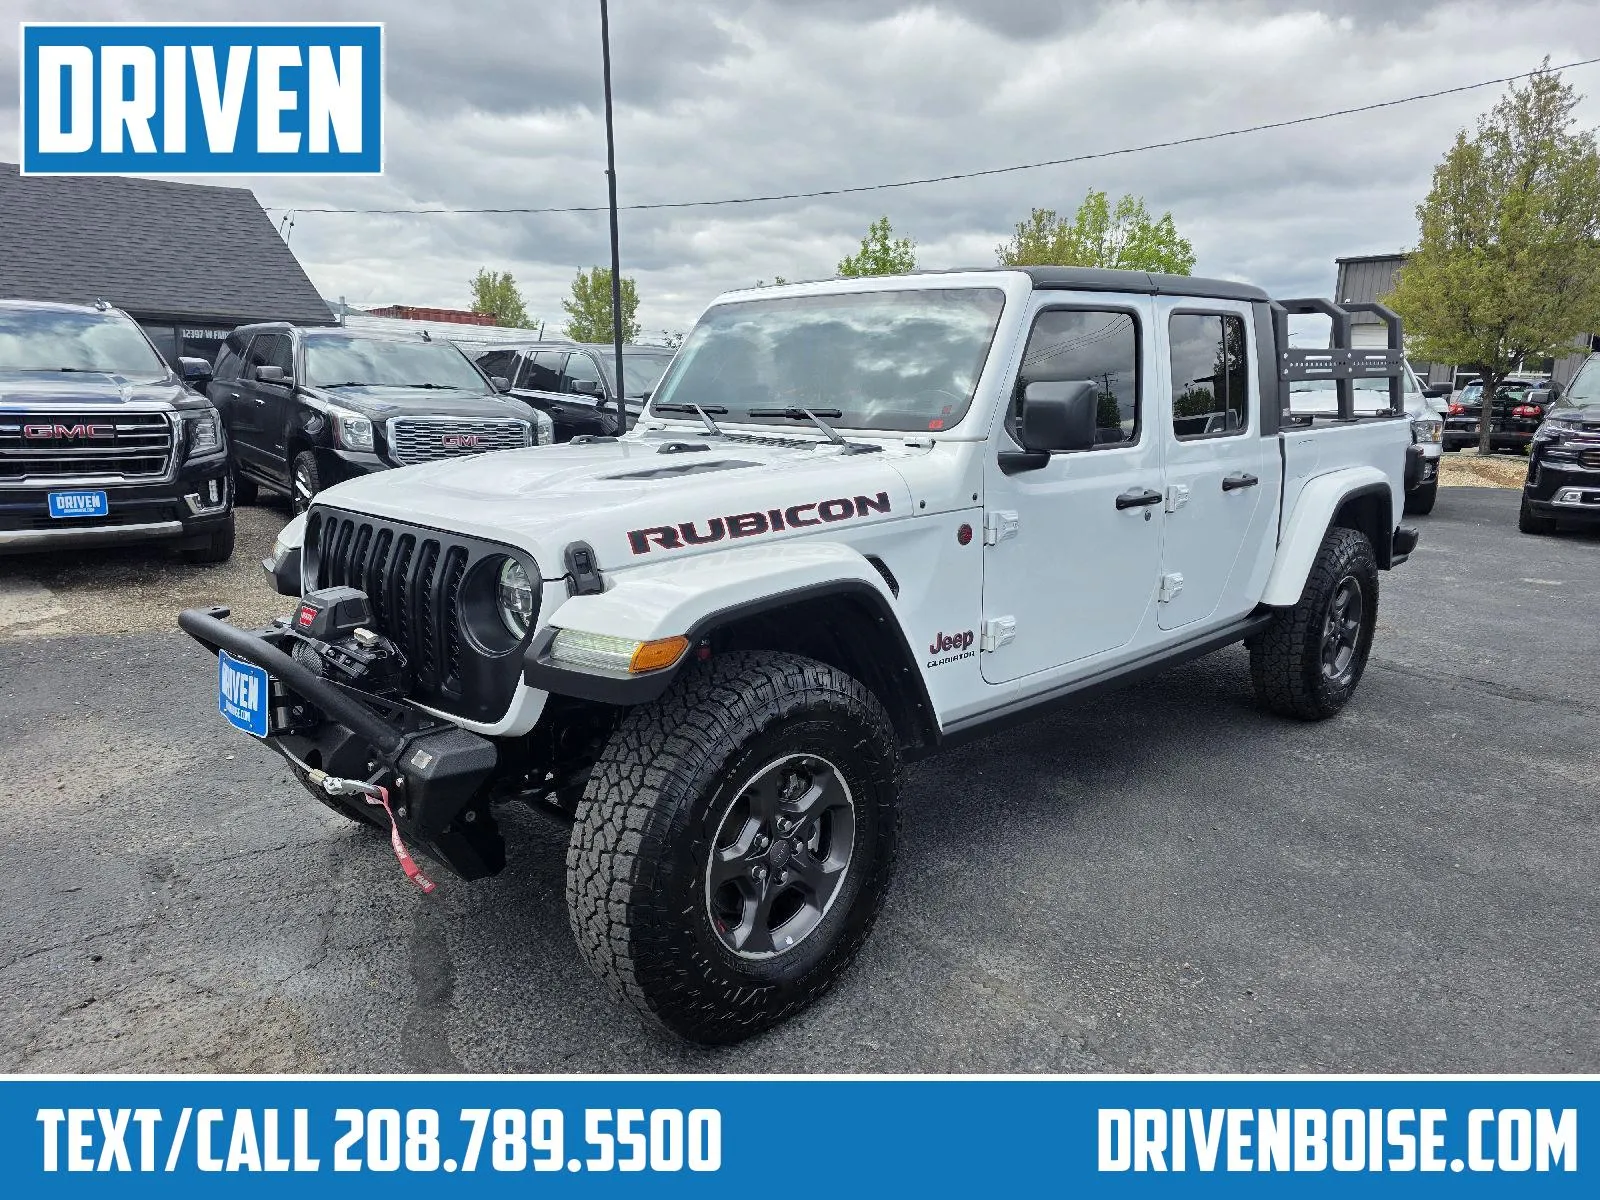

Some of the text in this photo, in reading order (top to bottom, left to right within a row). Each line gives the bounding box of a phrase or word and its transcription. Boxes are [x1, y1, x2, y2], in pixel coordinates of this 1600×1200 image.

[182, 329, 204, 339] 12397
[205, 329, 213, 339] W
[23, 424, 115, 439] GMC
[442, 433, 489, 449] GMC
[55, 495, 101, 510] DRIVEN
[626, 491, 891, 556] RUBICON
[929, 629, 974, 655] Jeep
[926, 650, 975, 669] GLADIATOR
